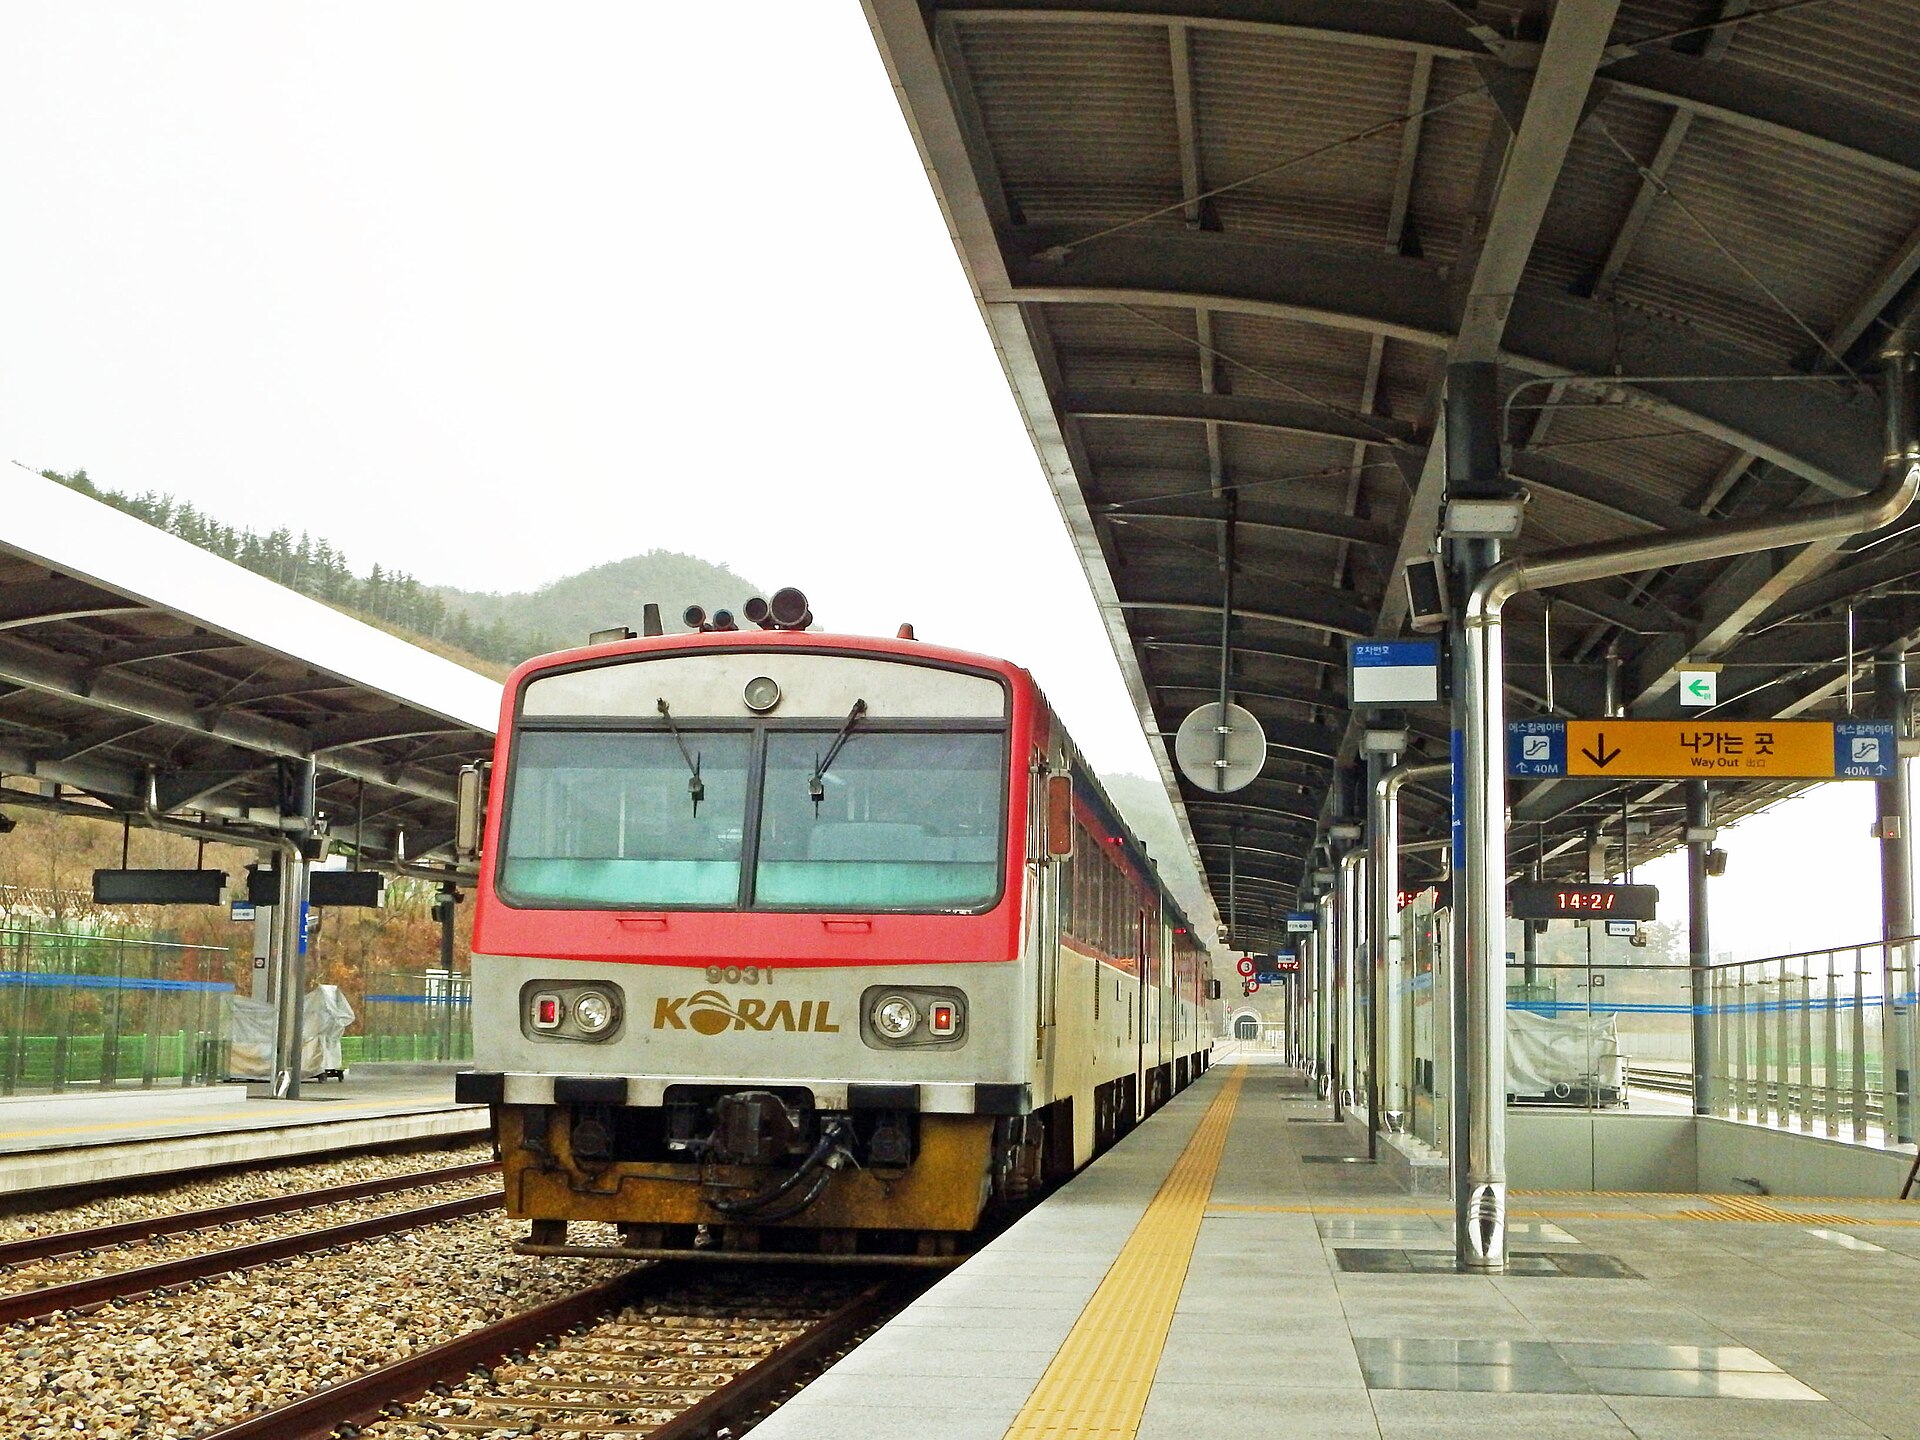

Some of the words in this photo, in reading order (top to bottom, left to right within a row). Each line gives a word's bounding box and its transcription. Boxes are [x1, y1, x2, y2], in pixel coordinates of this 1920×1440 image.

[1680, 732, 1744, 754] 나가는
[1754, 732, 1775, 755] 곳
[1690, 757, 1715, 769] Way
[1717, 757, 1739, 768] Out
[1745, 758, 1766, 768] 出口
[1533, 764, 1559, 774] 40M
[1844, 766, 1870, 776] 40M
[1244, 963, 1251, 972] 3
[705, 965, 774, 985] 9031
[653, 990, 840, 1036] KORAIL
